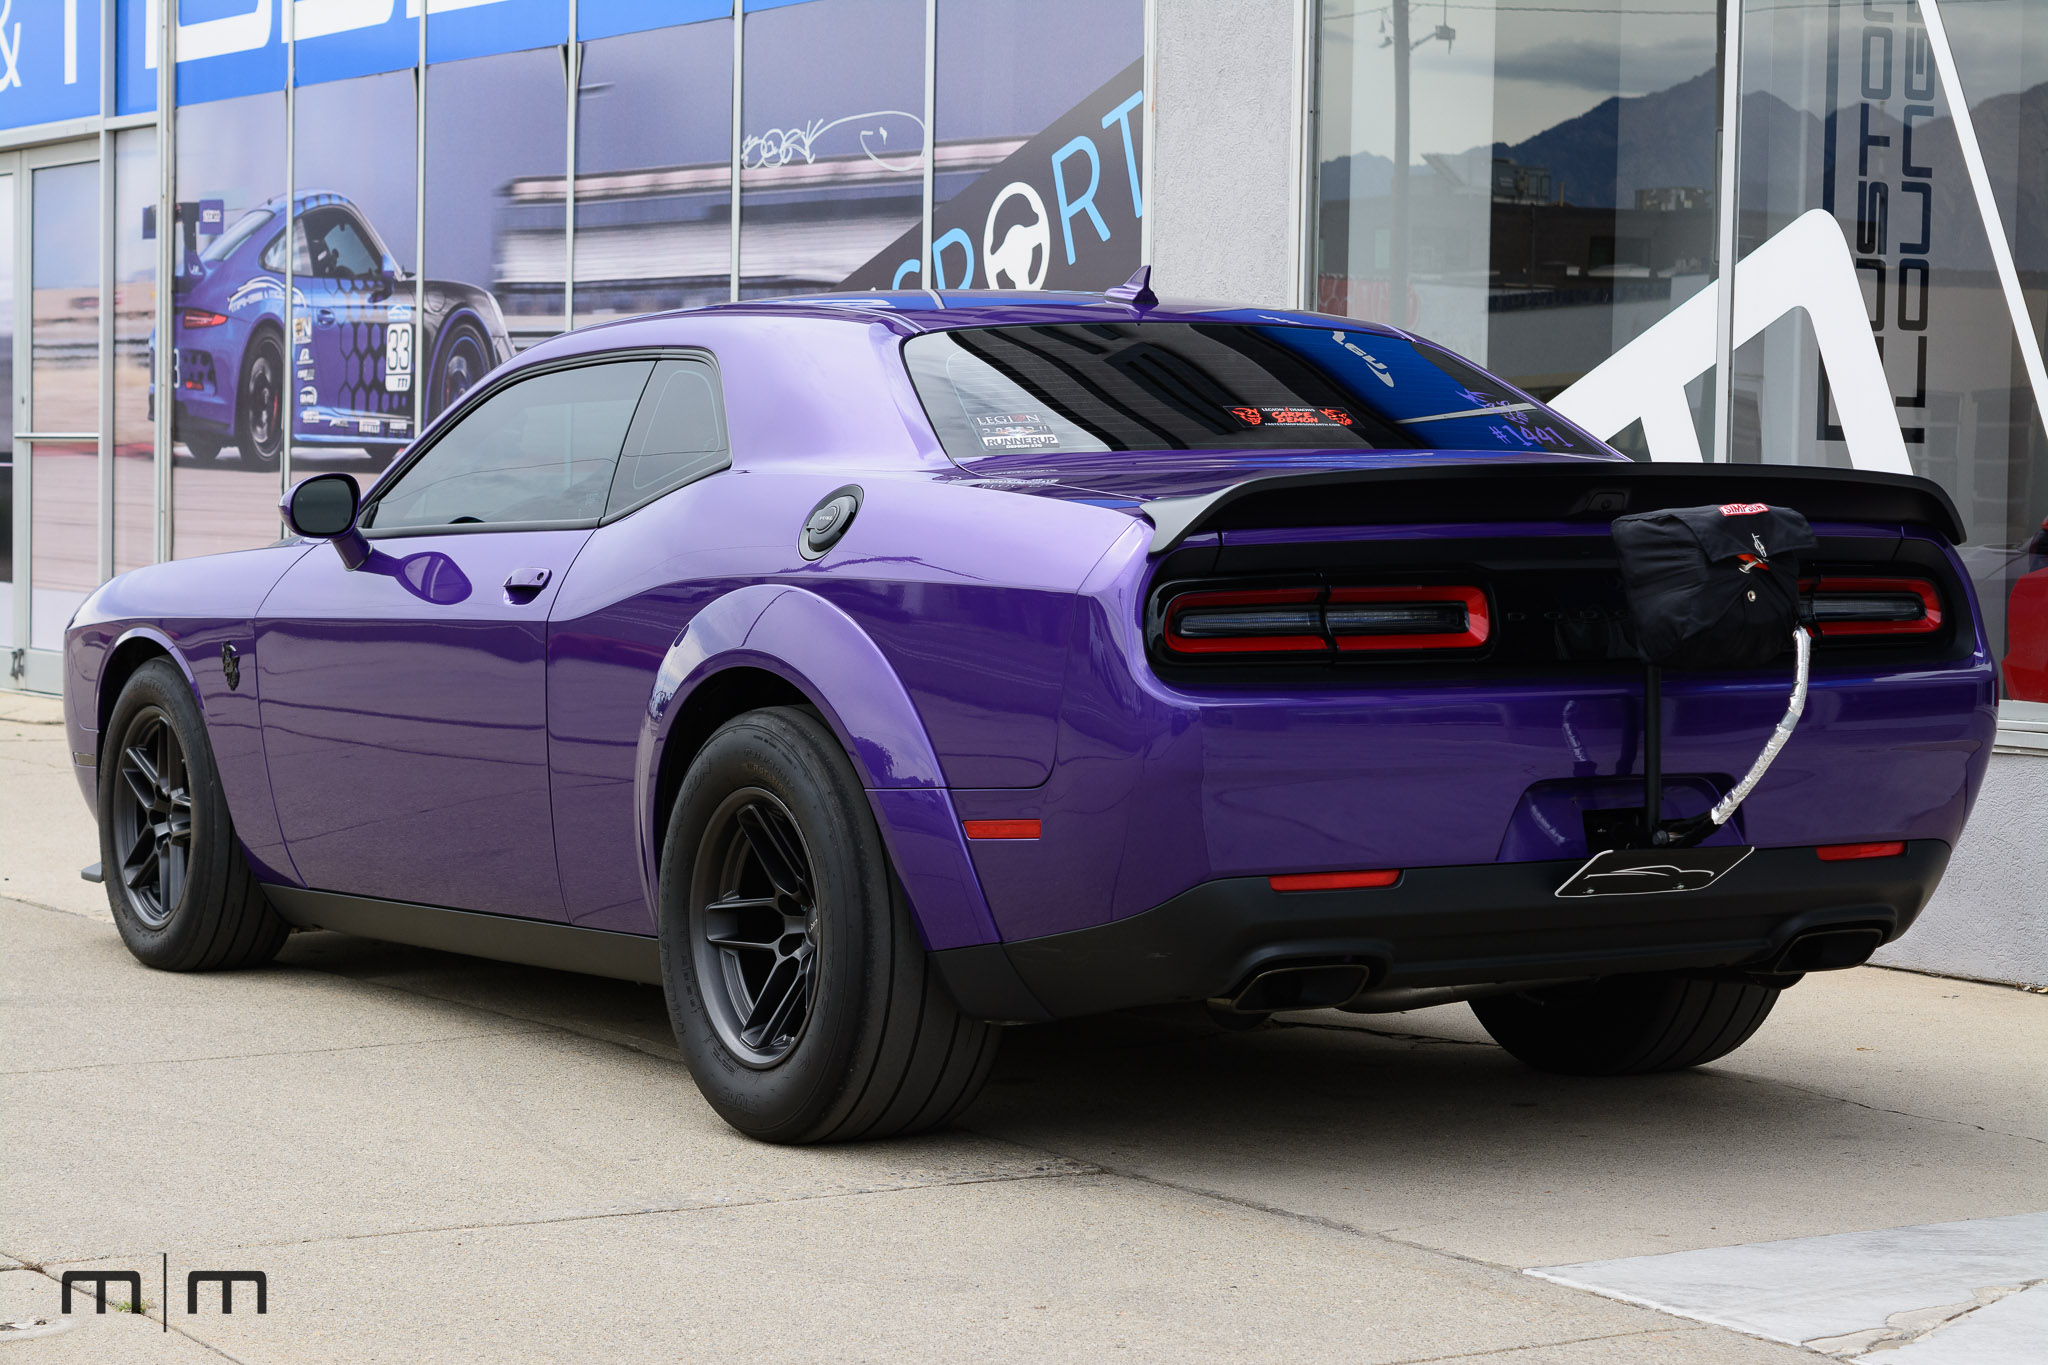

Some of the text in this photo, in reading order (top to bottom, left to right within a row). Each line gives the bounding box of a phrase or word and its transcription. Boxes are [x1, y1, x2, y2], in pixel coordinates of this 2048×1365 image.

[388, 329, 410, 371] 33
[986, 436, 1056, 447] RUNNERUP
[1725, 504, 1765, 514] SIMPSON
